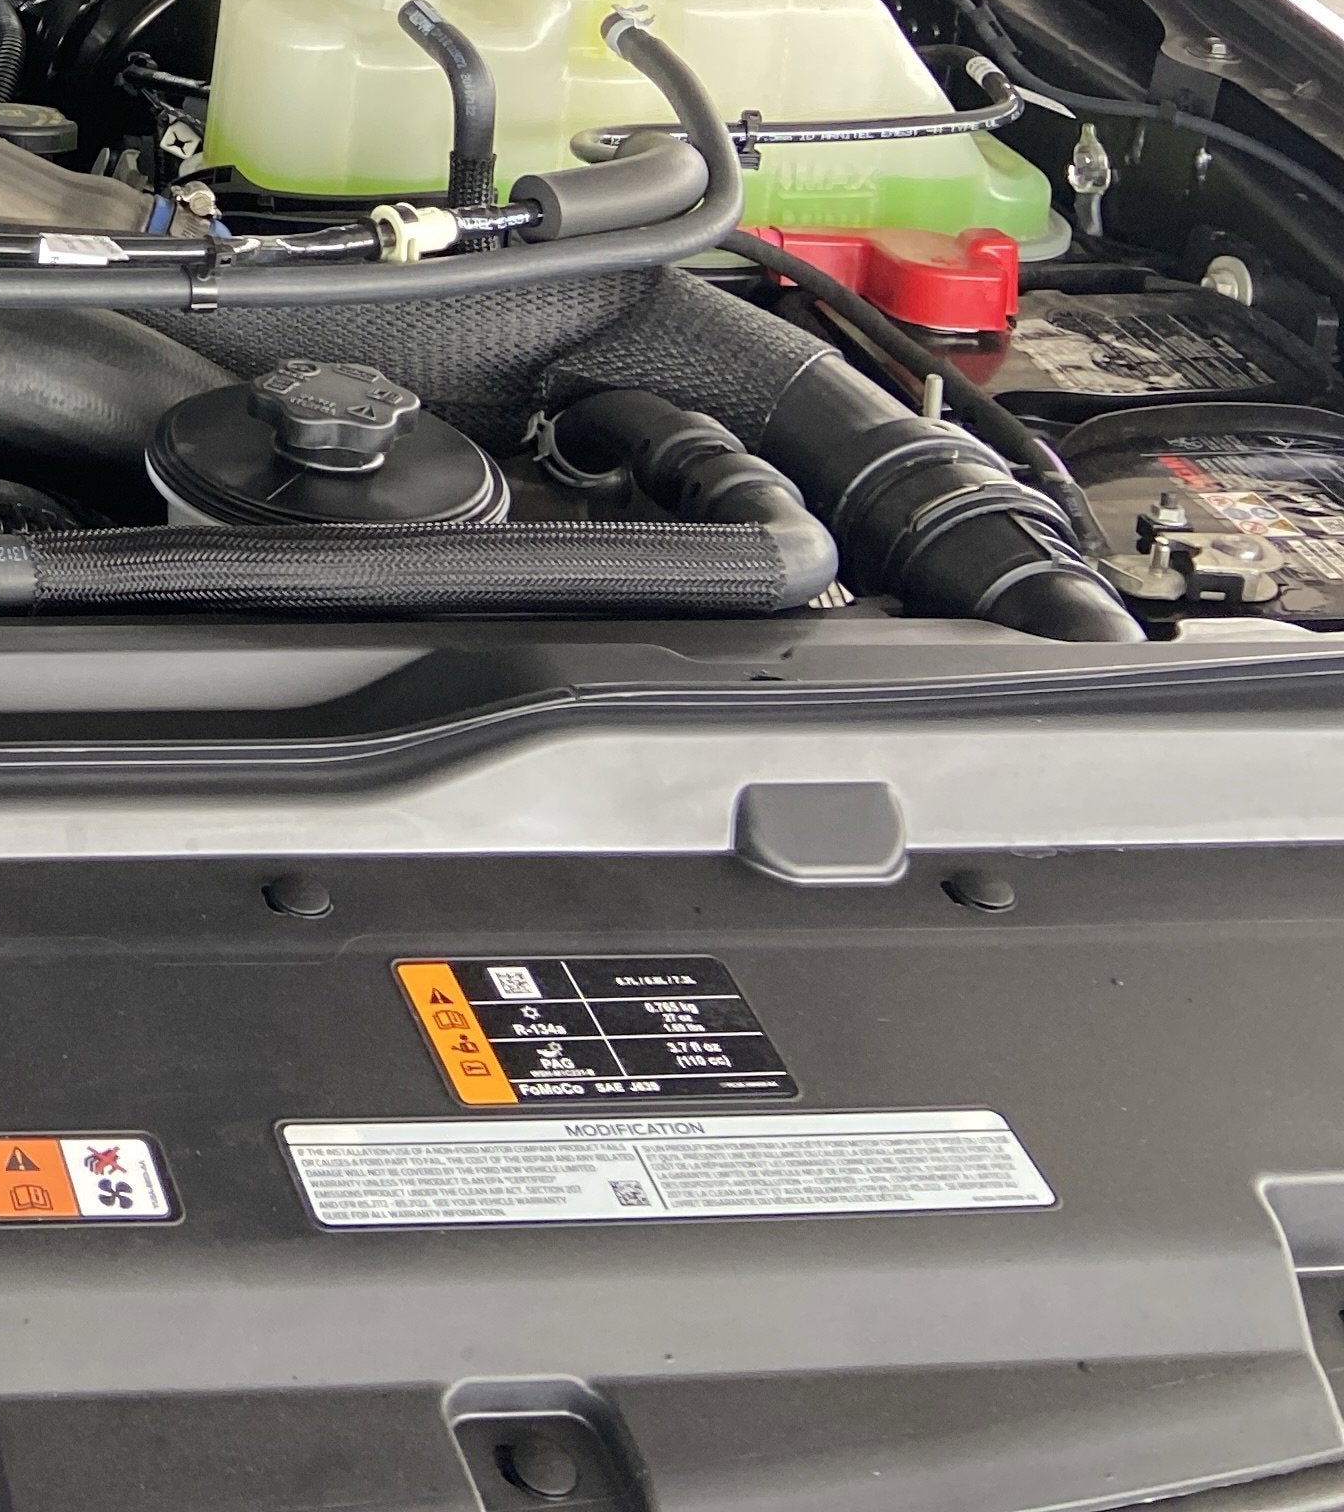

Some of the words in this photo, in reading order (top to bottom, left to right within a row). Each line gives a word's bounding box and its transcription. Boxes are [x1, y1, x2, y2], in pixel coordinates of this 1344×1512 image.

[678, 1001, 700, 1015] kg
[512, 1023, 567, 1036] R-134a
[703, 1042, 723, 1053] oz
[540, 1057, 576, 1070] PAG
[676, 1054, 707, 1069] (110
[707, 1054, 733, 1069] cc)
[518, 1082, 585, 1097] FoMoCo
[594, 1082, 626, 1094] SAE
[564, 1121, 707, 1138] MODIFICATION
[309, 1148, 325, 1156] THE
